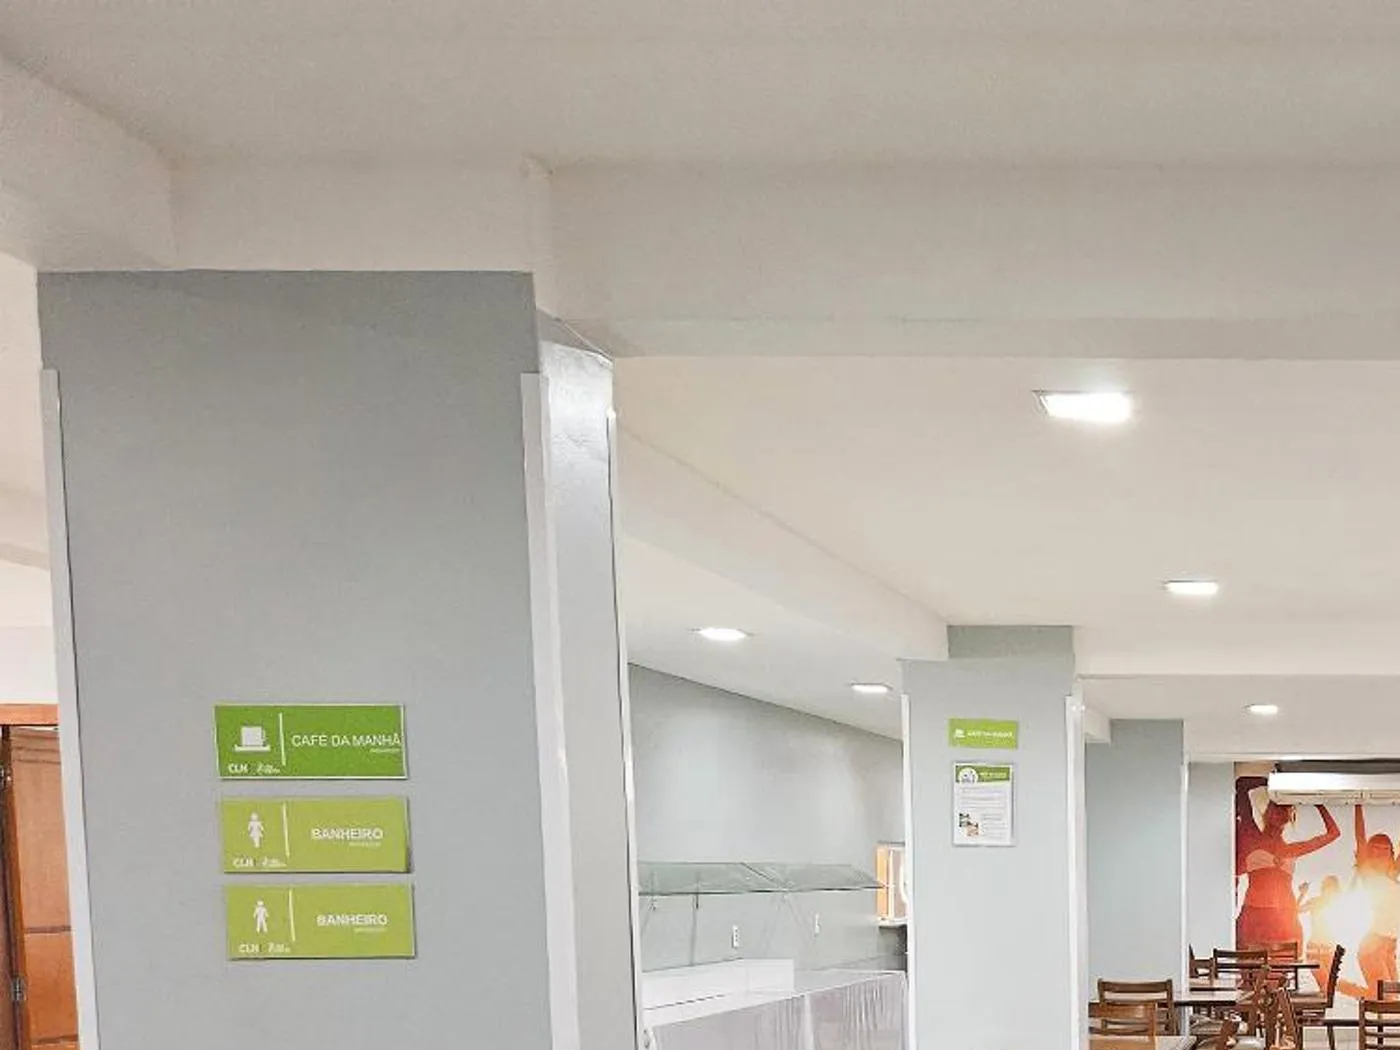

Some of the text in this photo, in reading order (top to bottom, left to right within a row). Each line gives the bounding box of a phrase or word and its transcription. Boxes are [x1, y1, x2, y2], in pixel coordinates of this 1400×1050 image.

[331, 734, 351, 747] DA
[311, 827, 384, 840] BANHEIRO
[316, 913, 388, 926] BANHEIRO
